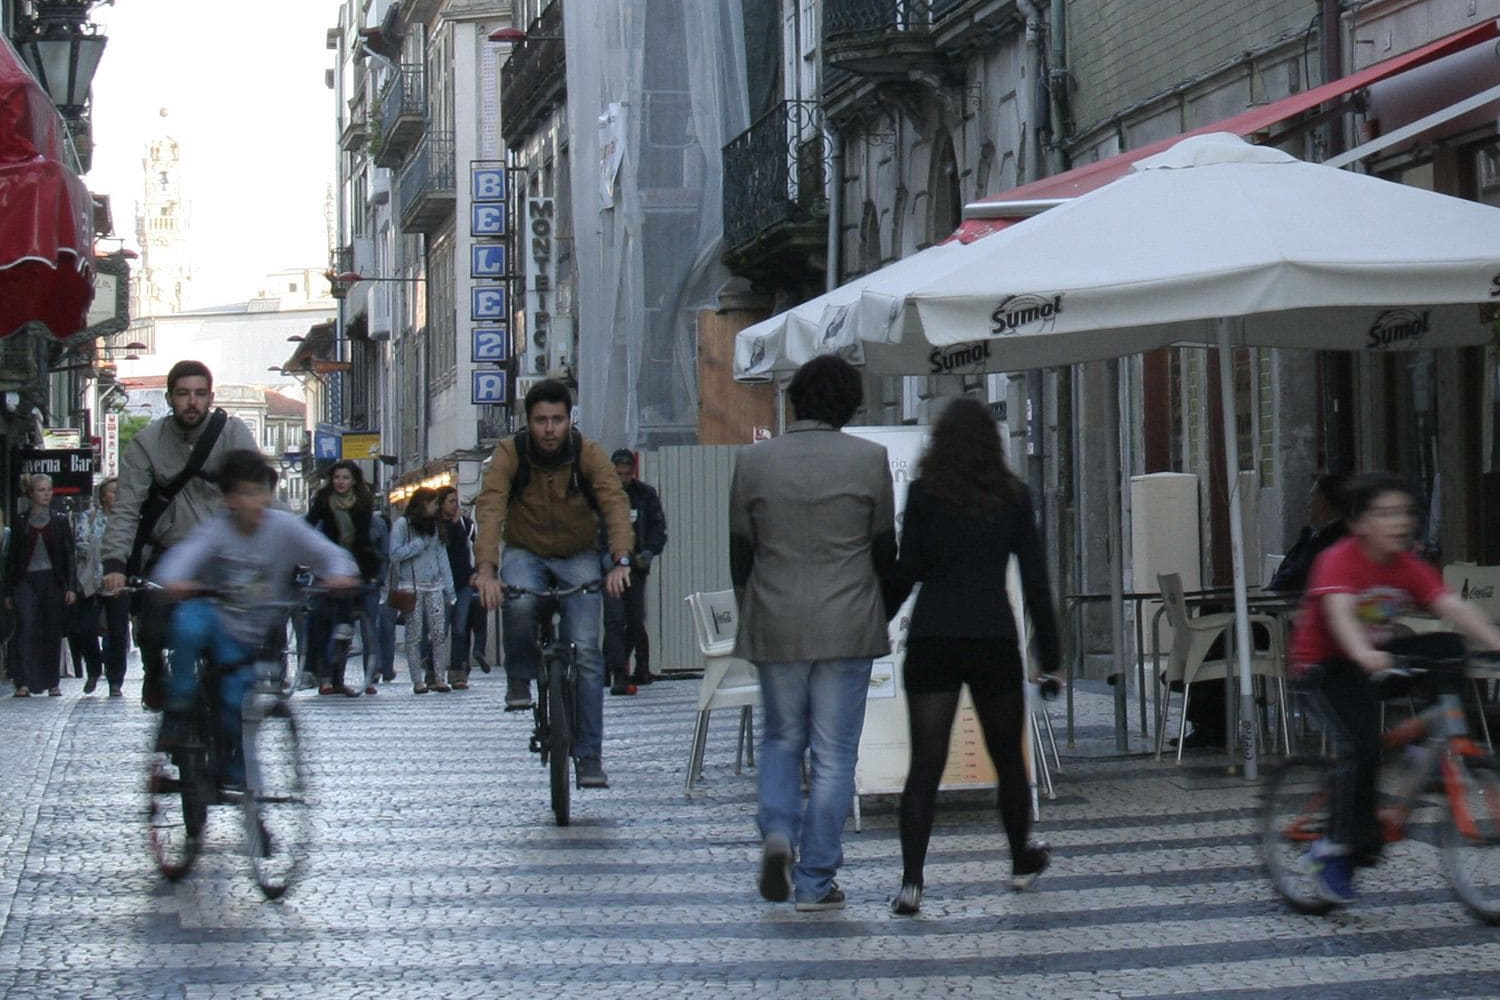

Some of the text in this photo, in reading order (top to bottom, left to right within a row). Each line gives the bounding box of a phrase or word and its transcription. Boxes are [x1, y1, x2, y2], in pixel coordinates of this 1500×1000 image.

[528, 200, 554, 373] MONTEIROS
[990, 295, 1064, 335] Sumol
[1366, 310, 1430, 349] Sumol
[928, 339, 992, 374] Sumol
[22, 454, 92, 473] averna Bar
